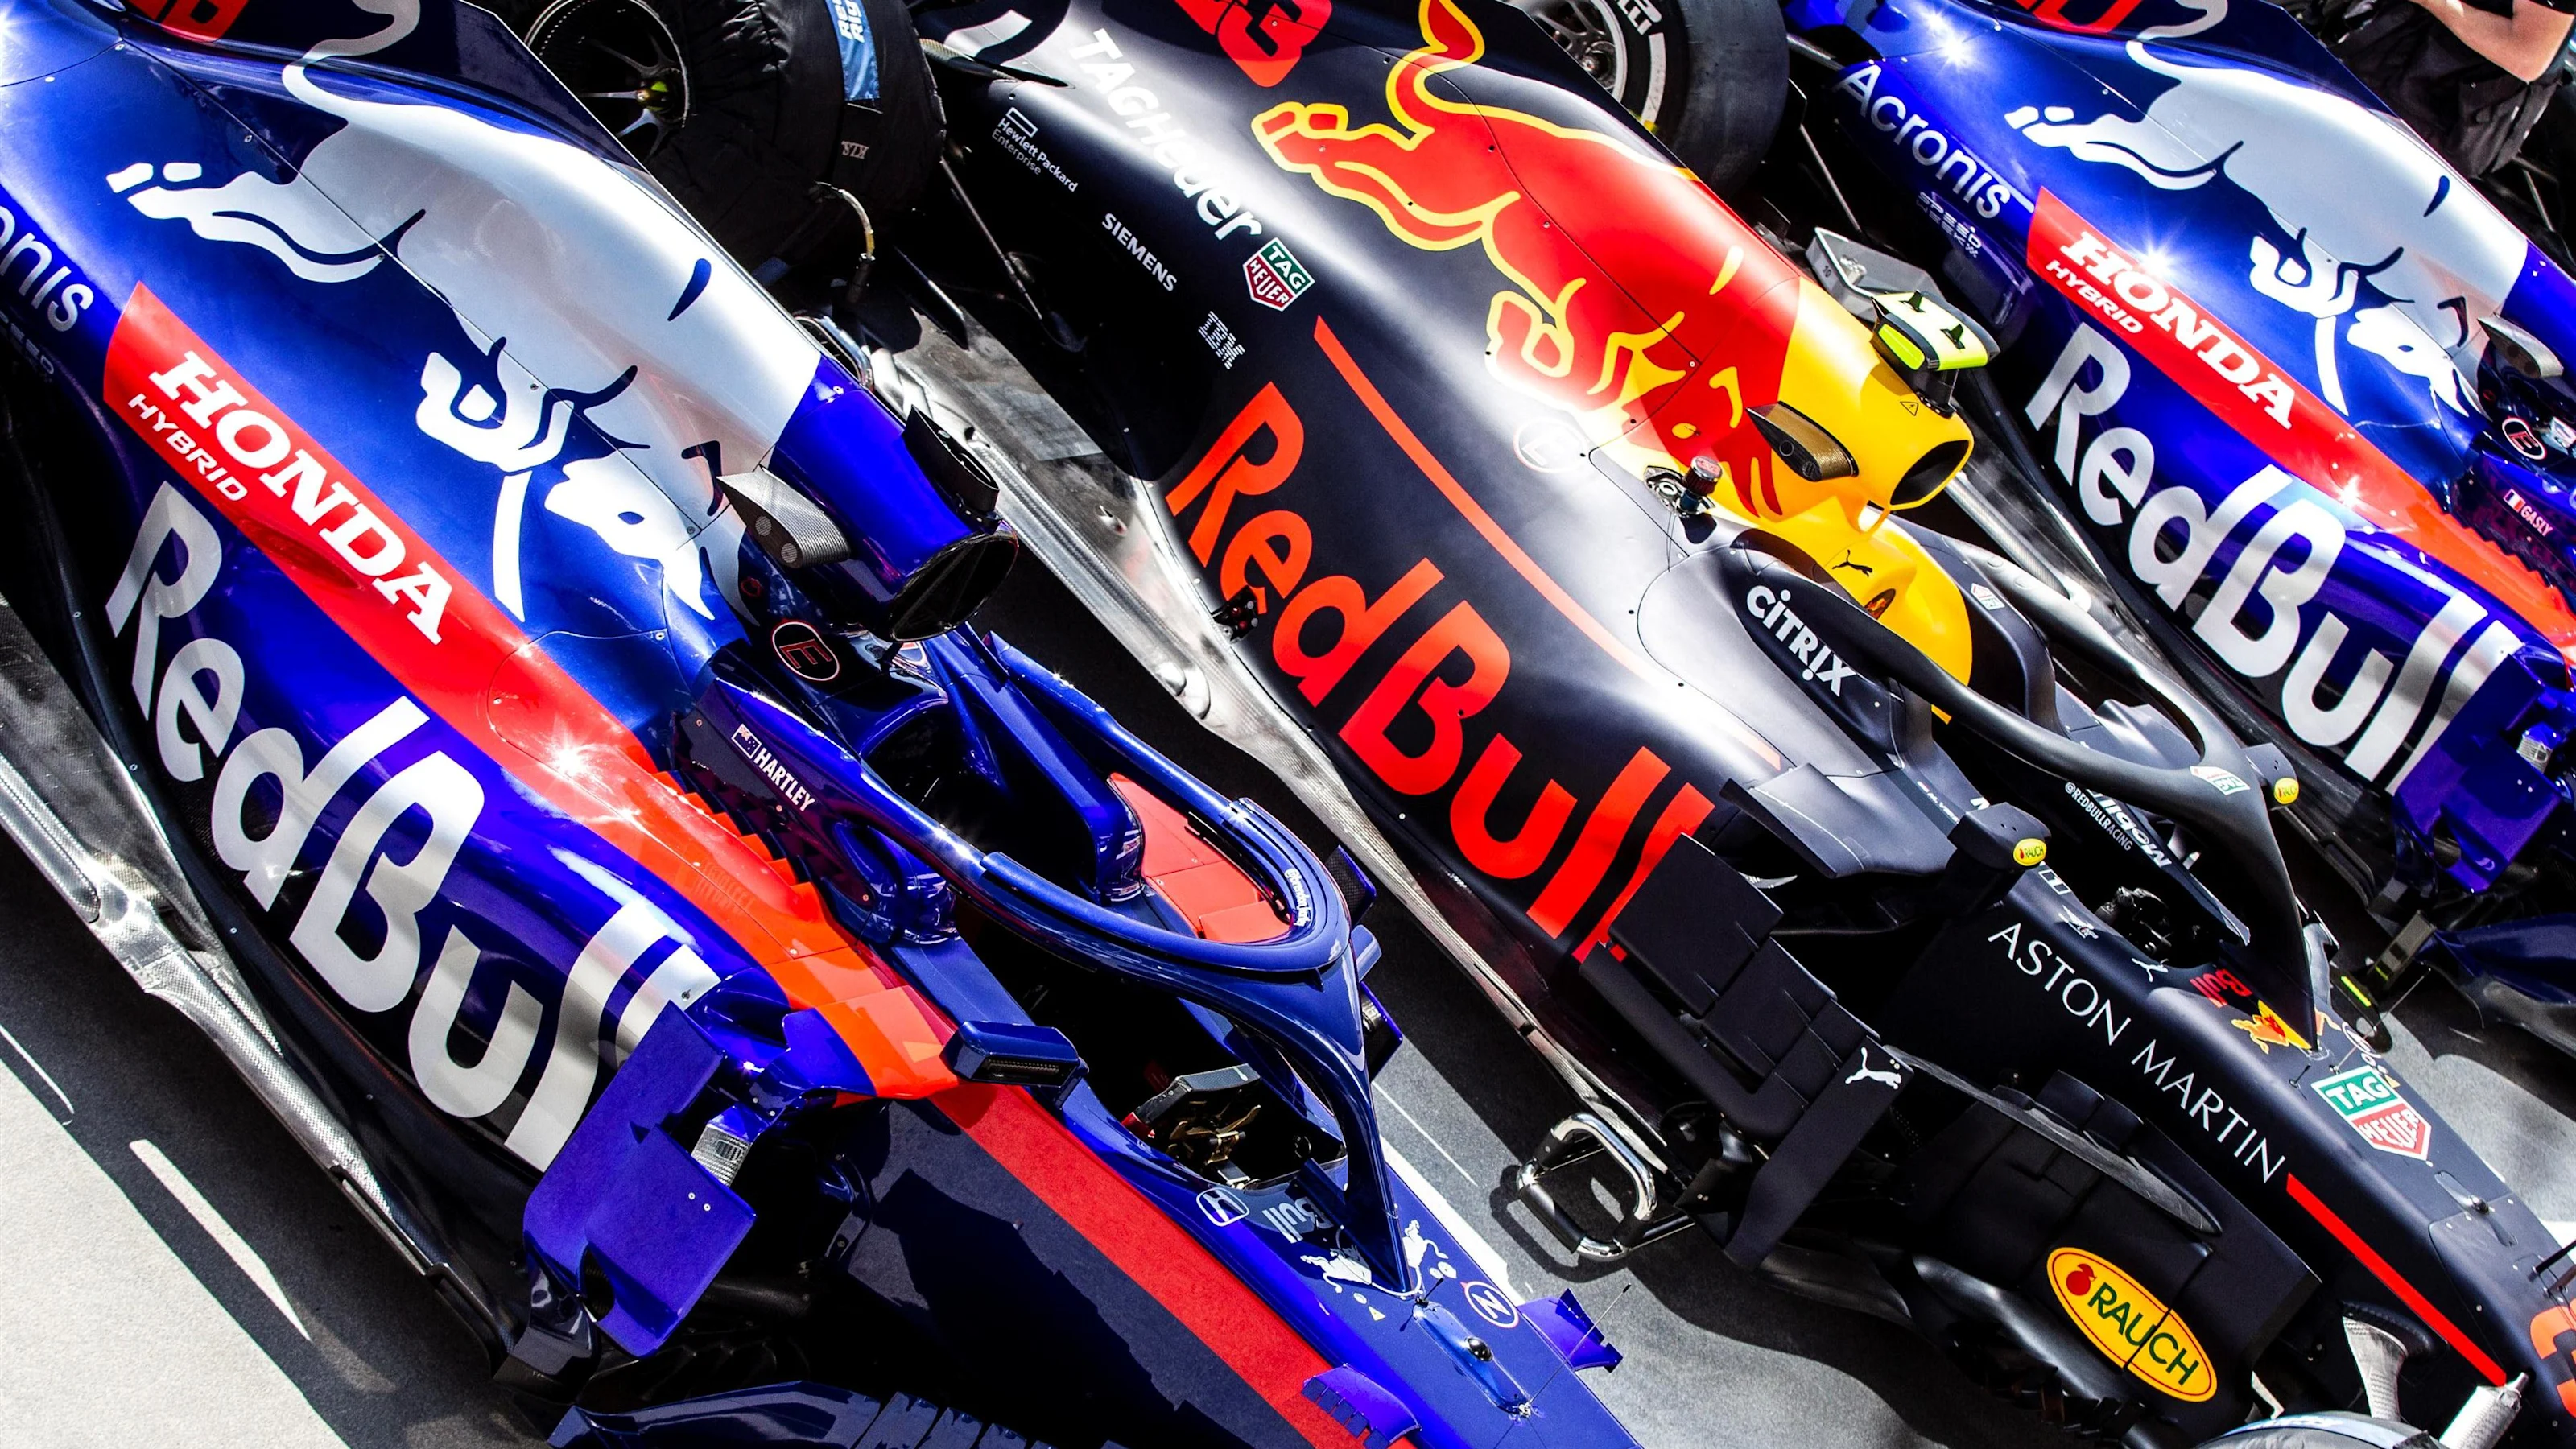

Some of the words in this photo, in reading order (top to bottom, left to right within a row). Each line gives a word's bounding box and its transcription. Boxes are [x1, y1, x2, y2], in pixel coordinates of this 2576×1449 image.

[992, 128, 1042, 175] Enterprise
[997, 118, 1039, 158] Hewlett
[1037, 151, 1079, 192] Packard
[1834, 64, 2011, 219] Acronis
[1102, 213, 1177, 292] SIEMENS
[1249, 257, 1290, 308] HEUER
[1267, 246, 1306, 291] TAG
[2046, 260, 2145, 334] HYBRID
[2058, 229, 2296, 430] HONDA
[1198, 310, 1245, 369] IBM
[127, 393, 249, 502] HYBRID
[148, 350, 452, 646] HONDA
[2520, 505, 2553, 537] GASLY
[778, 638, 833, 670] E
[753, 747, 815, 812] HARTLEY
[2065, 782, 2133, 851] @REDBULLRACING
[1988, 922, 2132, 1046] ASTON
[2132, 1038, 2286, 1184] MARTIN
[2324, 1075, 2390, 1112] TAG
[2358, 1108, 2420, 1150] HEUER
[2087, 1281, 2200, 1387] RAUCH
